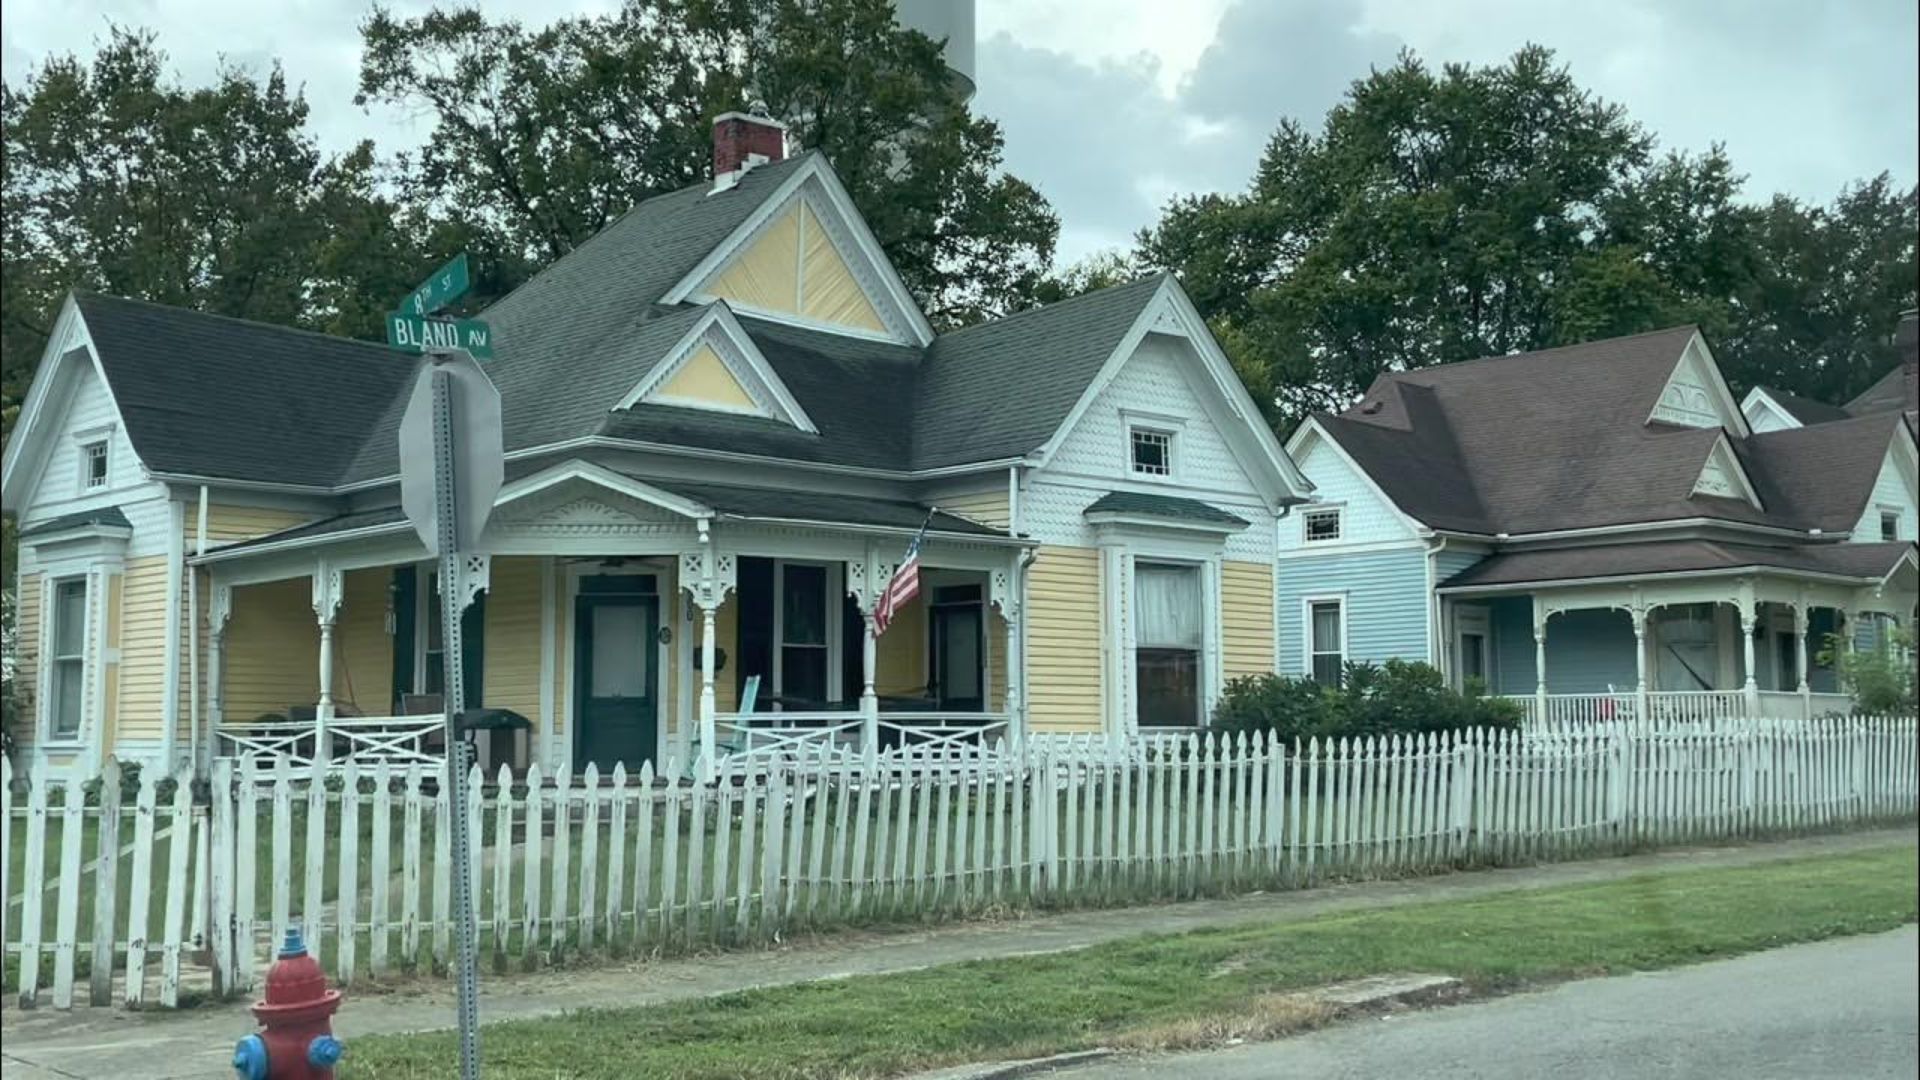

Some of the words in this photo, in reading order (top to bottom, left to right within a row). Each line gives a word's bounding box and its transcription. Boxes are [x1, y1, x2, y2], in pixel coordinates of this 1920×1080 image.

[442, 274, 451, 291] ST
[395, 318, 459, 348] BLAND
[469, 330, 486, 346] AV
